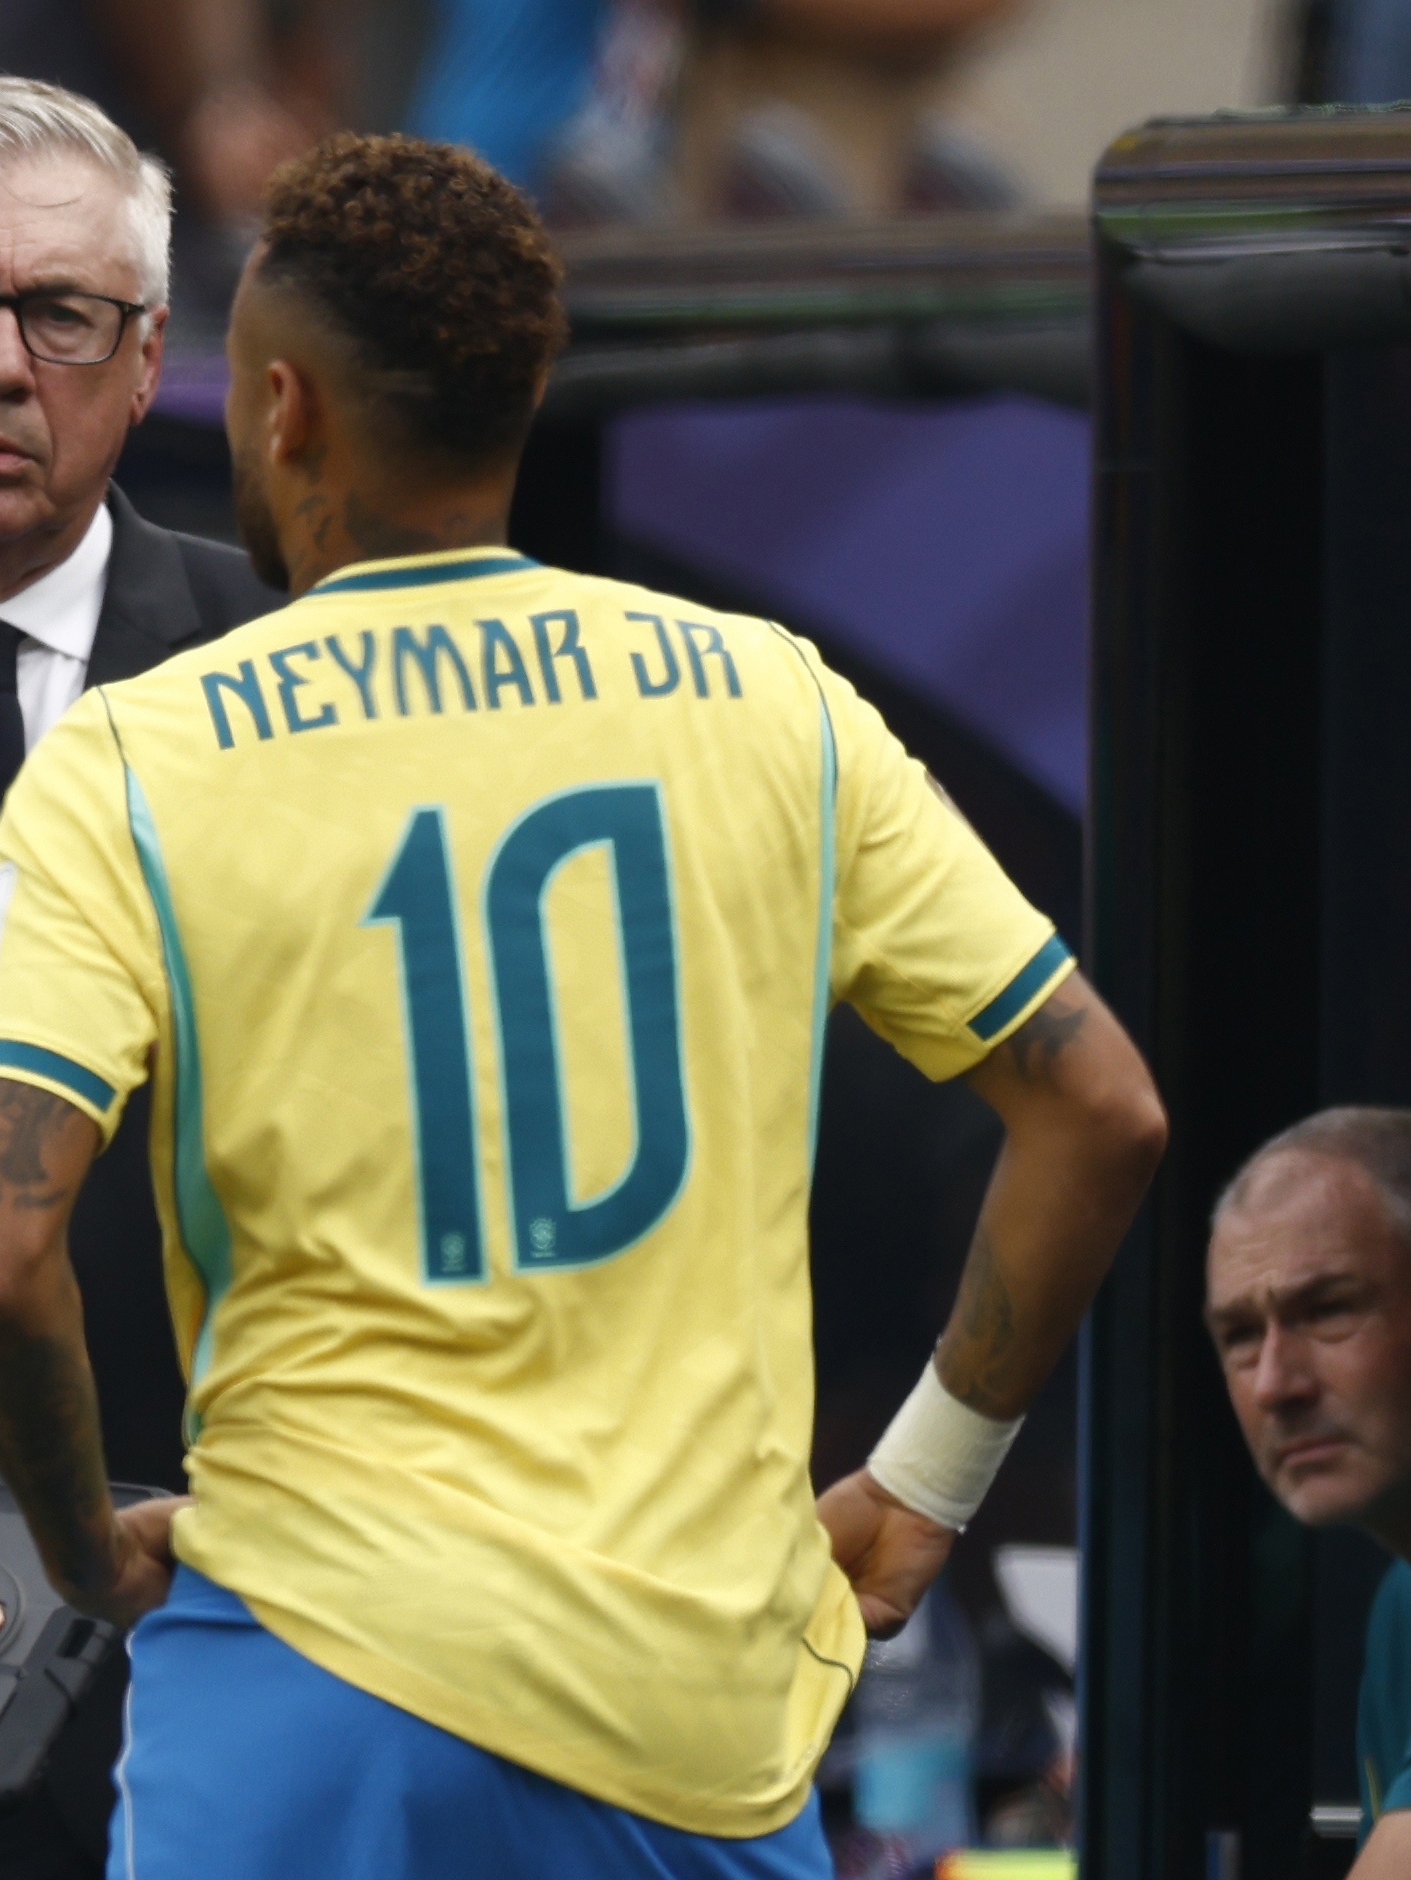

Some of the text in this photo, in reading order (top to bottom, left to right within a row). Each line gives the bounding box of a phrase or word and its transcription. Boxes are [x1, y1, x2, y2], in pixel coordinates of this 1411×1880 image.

[199, 609, 743, 750] NEYMAR JR
[356, 778, 692, 1287] 10
